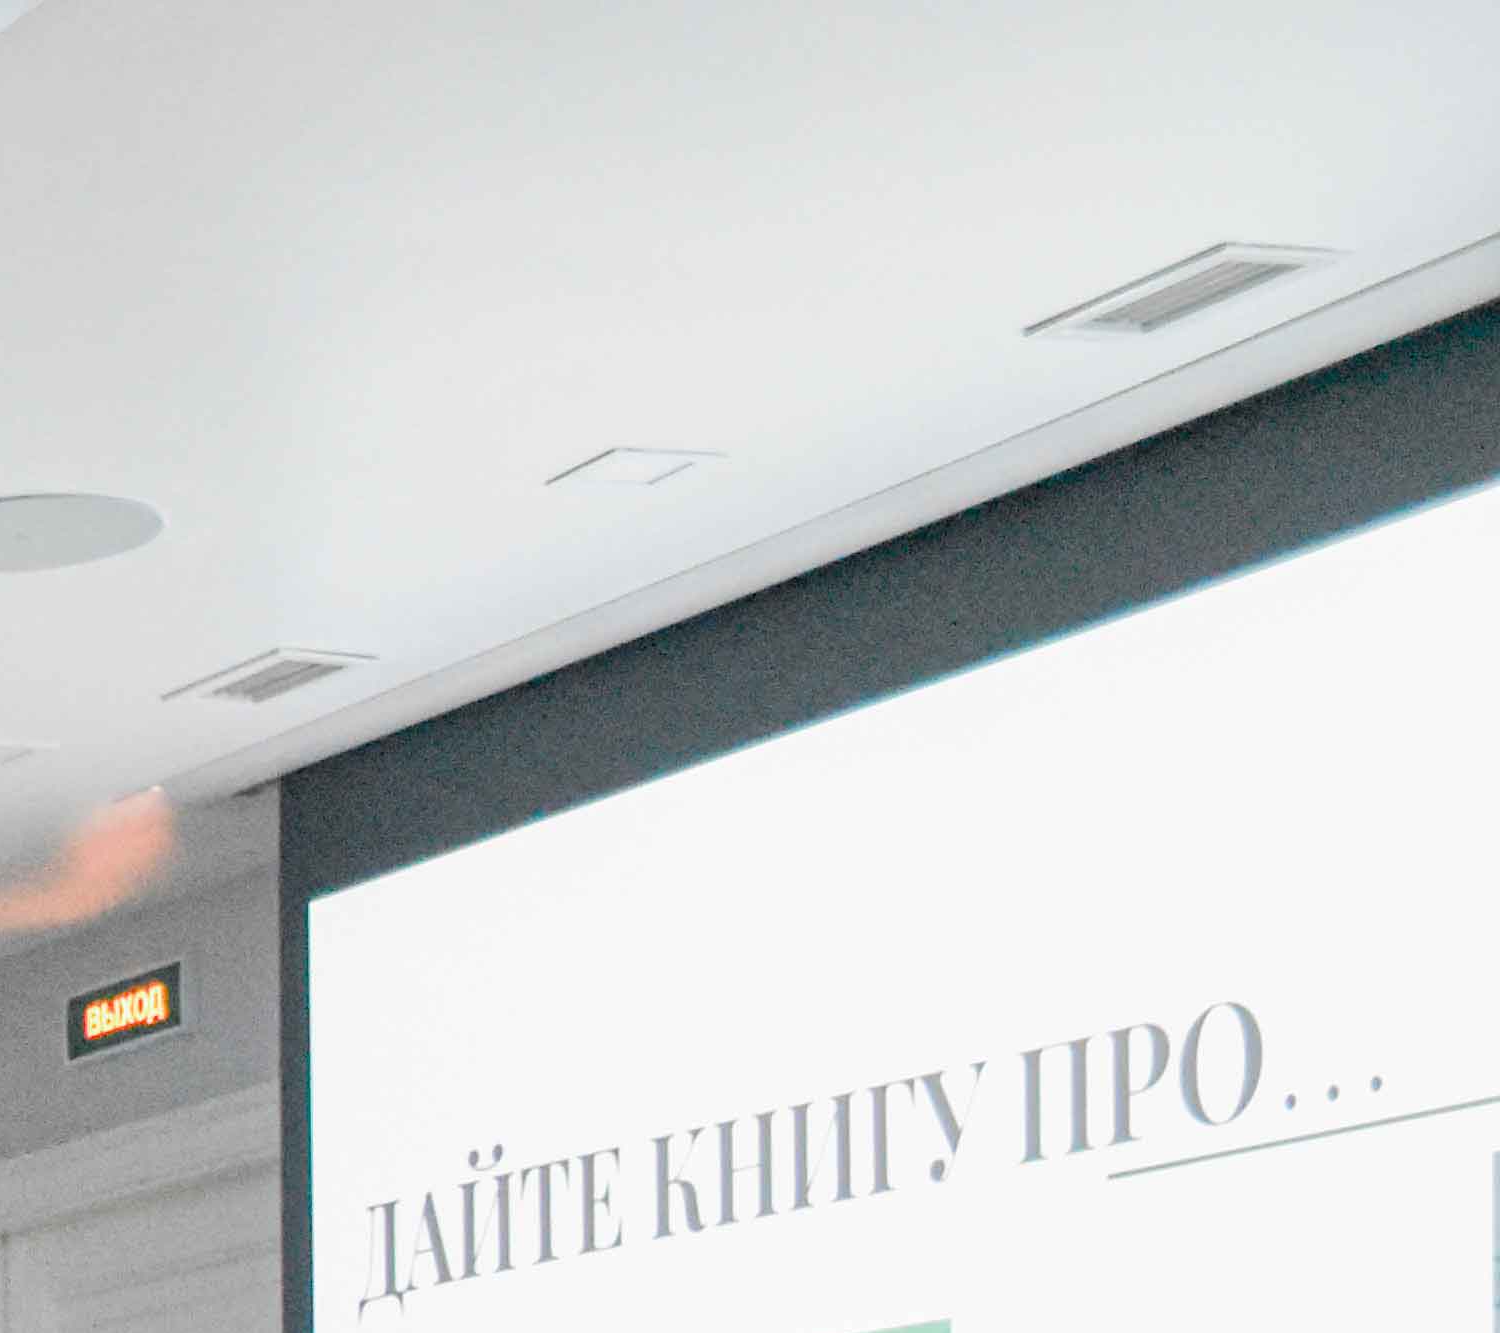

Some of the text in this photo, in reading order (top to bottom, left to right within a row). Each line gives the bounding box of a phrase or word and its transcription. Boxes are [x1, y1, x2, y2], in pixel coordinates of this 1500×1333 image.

[84, 981, 169, 1040] ВЫХОД
[357, 1142, 624, 1323] ДАЙТЕ
[648, 1060, 988, 1241] КНИГУ
